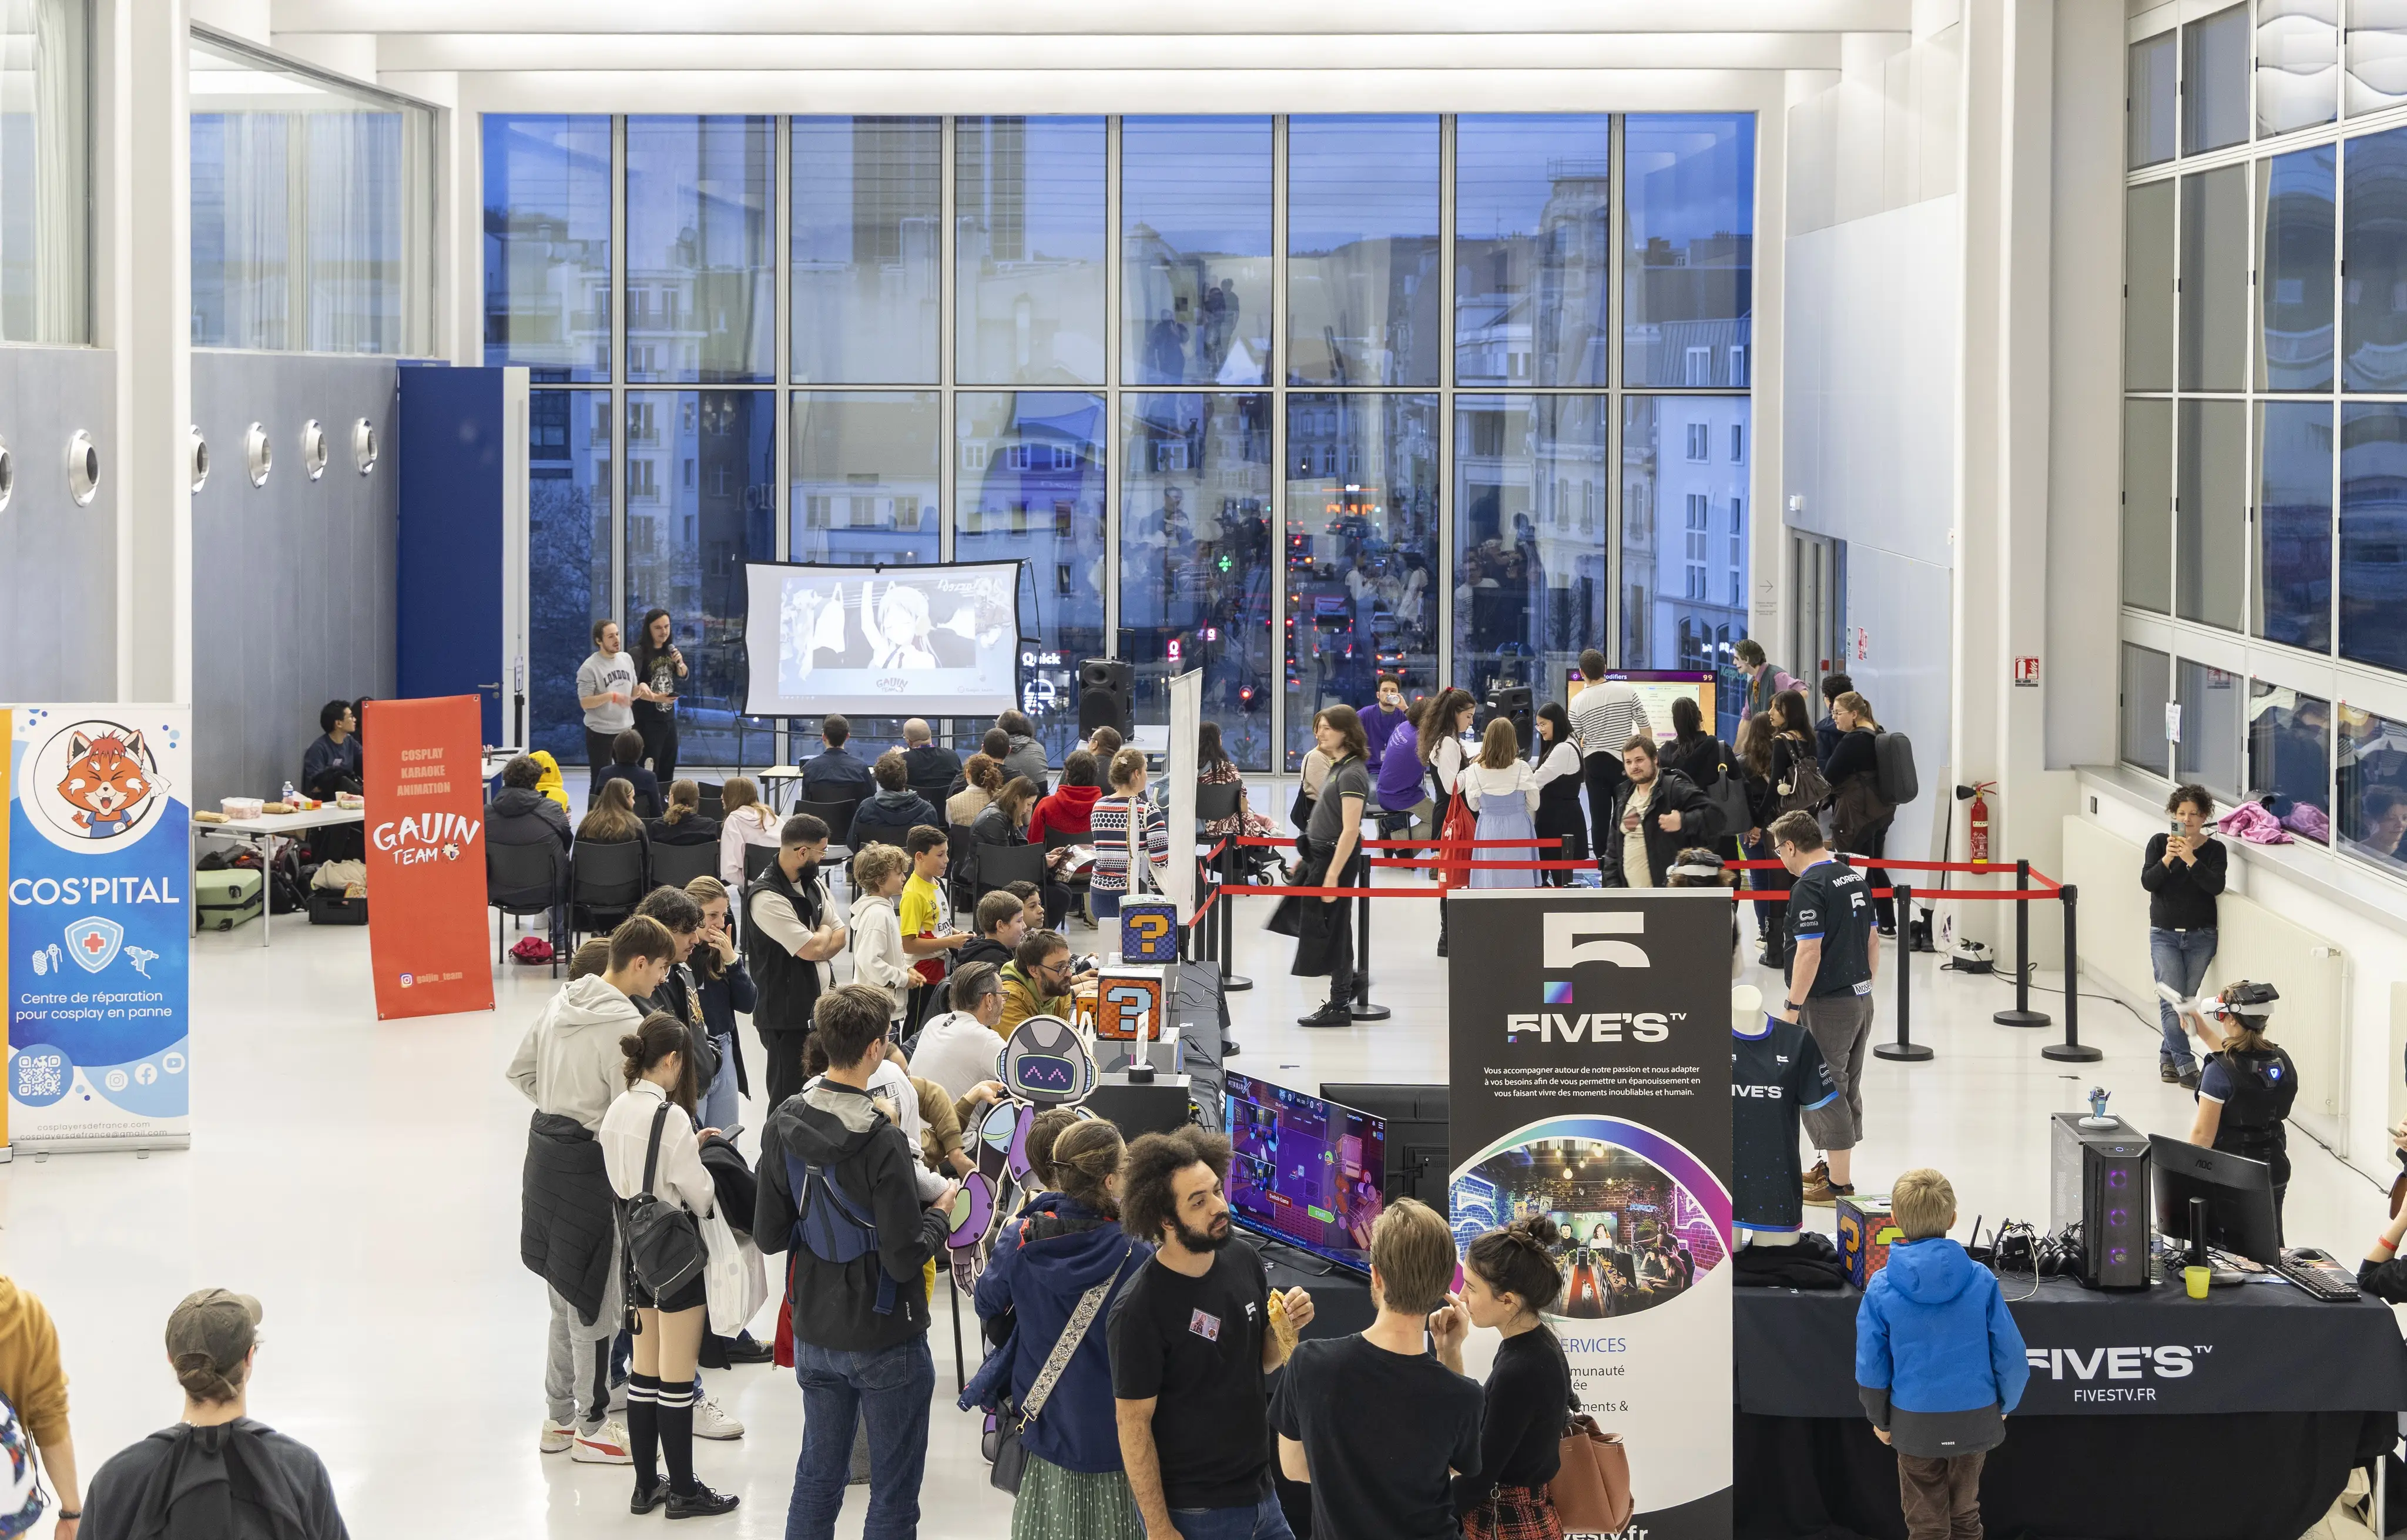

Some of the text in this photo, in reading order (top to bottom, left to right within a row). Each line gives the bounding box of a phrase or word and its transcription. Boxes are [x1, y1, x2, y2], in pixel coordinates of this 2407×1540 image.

[1022, 652, 1061, 667] Quick
[604, 669, 631, 688] LONDON
[401, 748, 444, 761] COSPLAY
[401, 765, 445, 779] KARAOKE
[397, 782, 451, 796] ANIMATION
[373, 813, 481, 851] GAIJIN
[392, 847, 438, 865] TEAM
[9, 877, 180, 905] COS'PITAL
[417, 971, 462, 984] gaijin_team
[21, 991, 163, 1005] Centre de réparation
[16, 1006, 172, 1023] pour cosplay en panne
[1613, 1065, 1641, 1074] passion
[1671, 1065, 1700, 1074] adapter
[1579, 1078, 1615, 1086] permettre
[1628, 1077, 1689, 1086] épanouissement
[1731, 1084, 1782, 1099] IVE'S
[37, 1120, 150, 1132] cosplayersdefrance.com
[2195, 1159, 2212, 1170] AOC
[1269, 1193, 1290, 1205] Switch Game
[1560, 1337, 1627, 1353] ERVICES
[2194, 1345, 2213, 1354] TV
[1570, 1364, 1624, 1376] munauté
[2074, 1388, 2156, 1403] FIVESTV.FR
[1580, 1400, 1628, 1411] ments &
